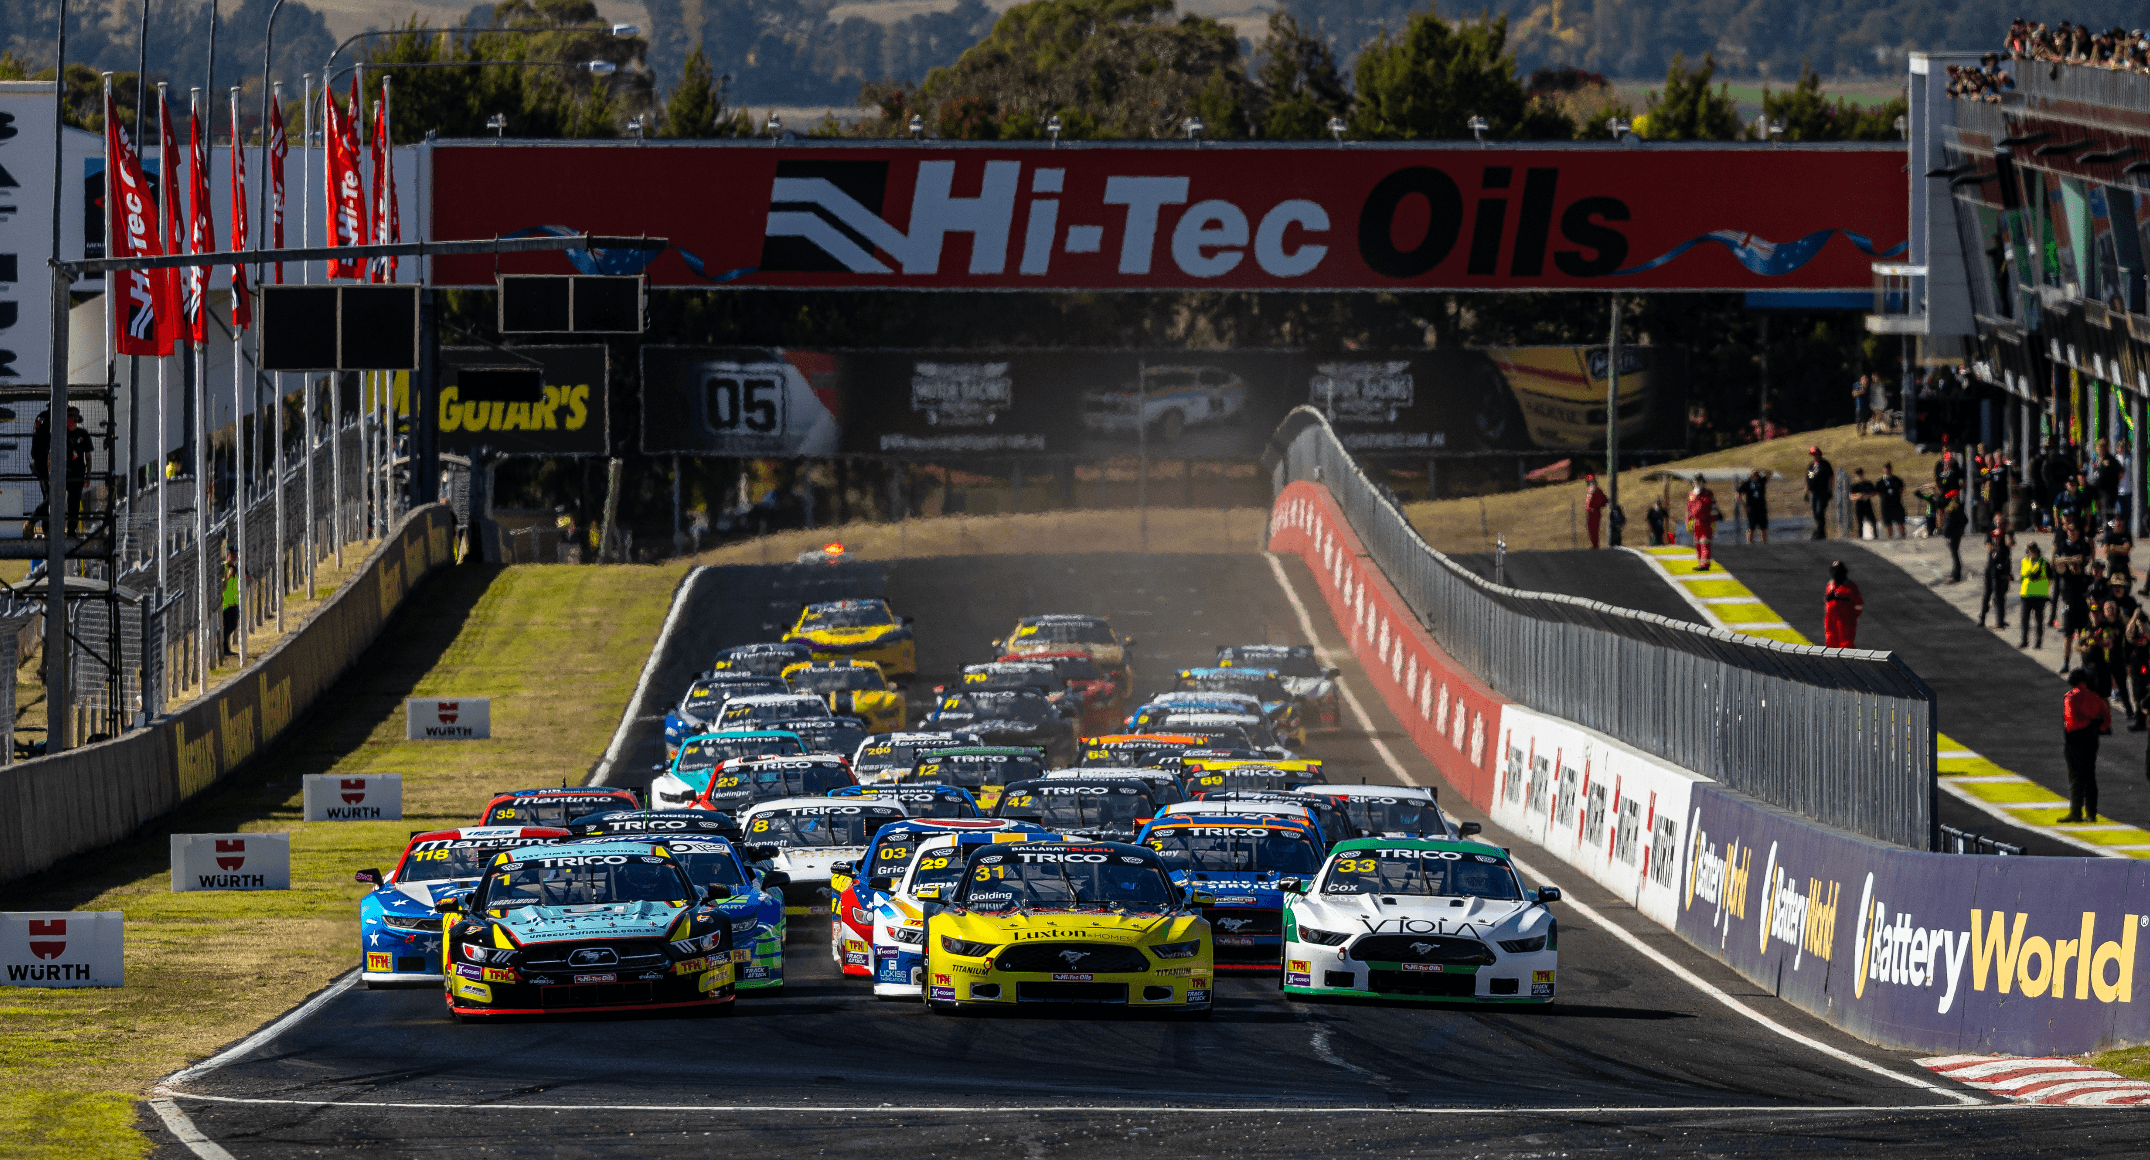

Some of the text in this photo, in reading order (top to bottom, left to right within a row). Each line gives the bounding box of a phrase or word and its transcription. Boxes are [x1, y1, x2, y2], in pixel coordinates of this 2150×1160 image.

[901, 159, 1632, 279] Hi-Tec Oils
[705, 377, 777, 432] 05
[867, 747, 891, 756] 200
[951, 755, 1008, 763] TRICO
[753, 761, 812, 771] TRICO
[918, 764, 940, 776] 12
[1220, 769, 1287, 778] TRICO
[717, 777, 739, 788] 23
[1200, 776, 1223, 786] 69
[1038, 787, 1109, 795] TRICO
[1007, 796, 1033, 807] 42
[1349, 796, 1398, 805] RICO
[327, 806, 381, 820] WÜRTH
[496, 808, 516, 820] 35
[787, 806, 861, 816] TRICO
[609, 820, 688, 831] TRICO
[752, 820, 769, 832] 8
[1188, 827, 1269, 837] TRICO
[414, 849, 450, 862] 118
[880, 847, 906, 860] 03
[1018, 853, 1108, 863] TRICO
[1376, 848, 1463, 861] TRICO
[539, 855, 627, 868] TRICO
[920, 858, 948, 870] 29
[1337, 859, 1376, 873] 33
[498, 873, 510, 886] 1
[975, 866, 1005, 881] 31
[199, 874, 264, 888] WÜRTH
[1327, 883, 1358, 892] Cox
[969, 892, 1013, 902] Golding
[1773, 867, 1840, 971] Battery World
[1014, 929, 1133, 942] Luxton HOMES
[1360, 919, 1481, 940] VIOLA
[369, 954, 388, 969] TFH
[1869, 901, 2139, 1014] Battery World
[7, 963, 90, 981] WÜRTH
[952, 964, 989, 976] TITANIUM
[1155, 967, 1192, 977] TITANIUM
[1292, 960, 1306, 972] TFH
[935, 974, 950, 985] TFH
